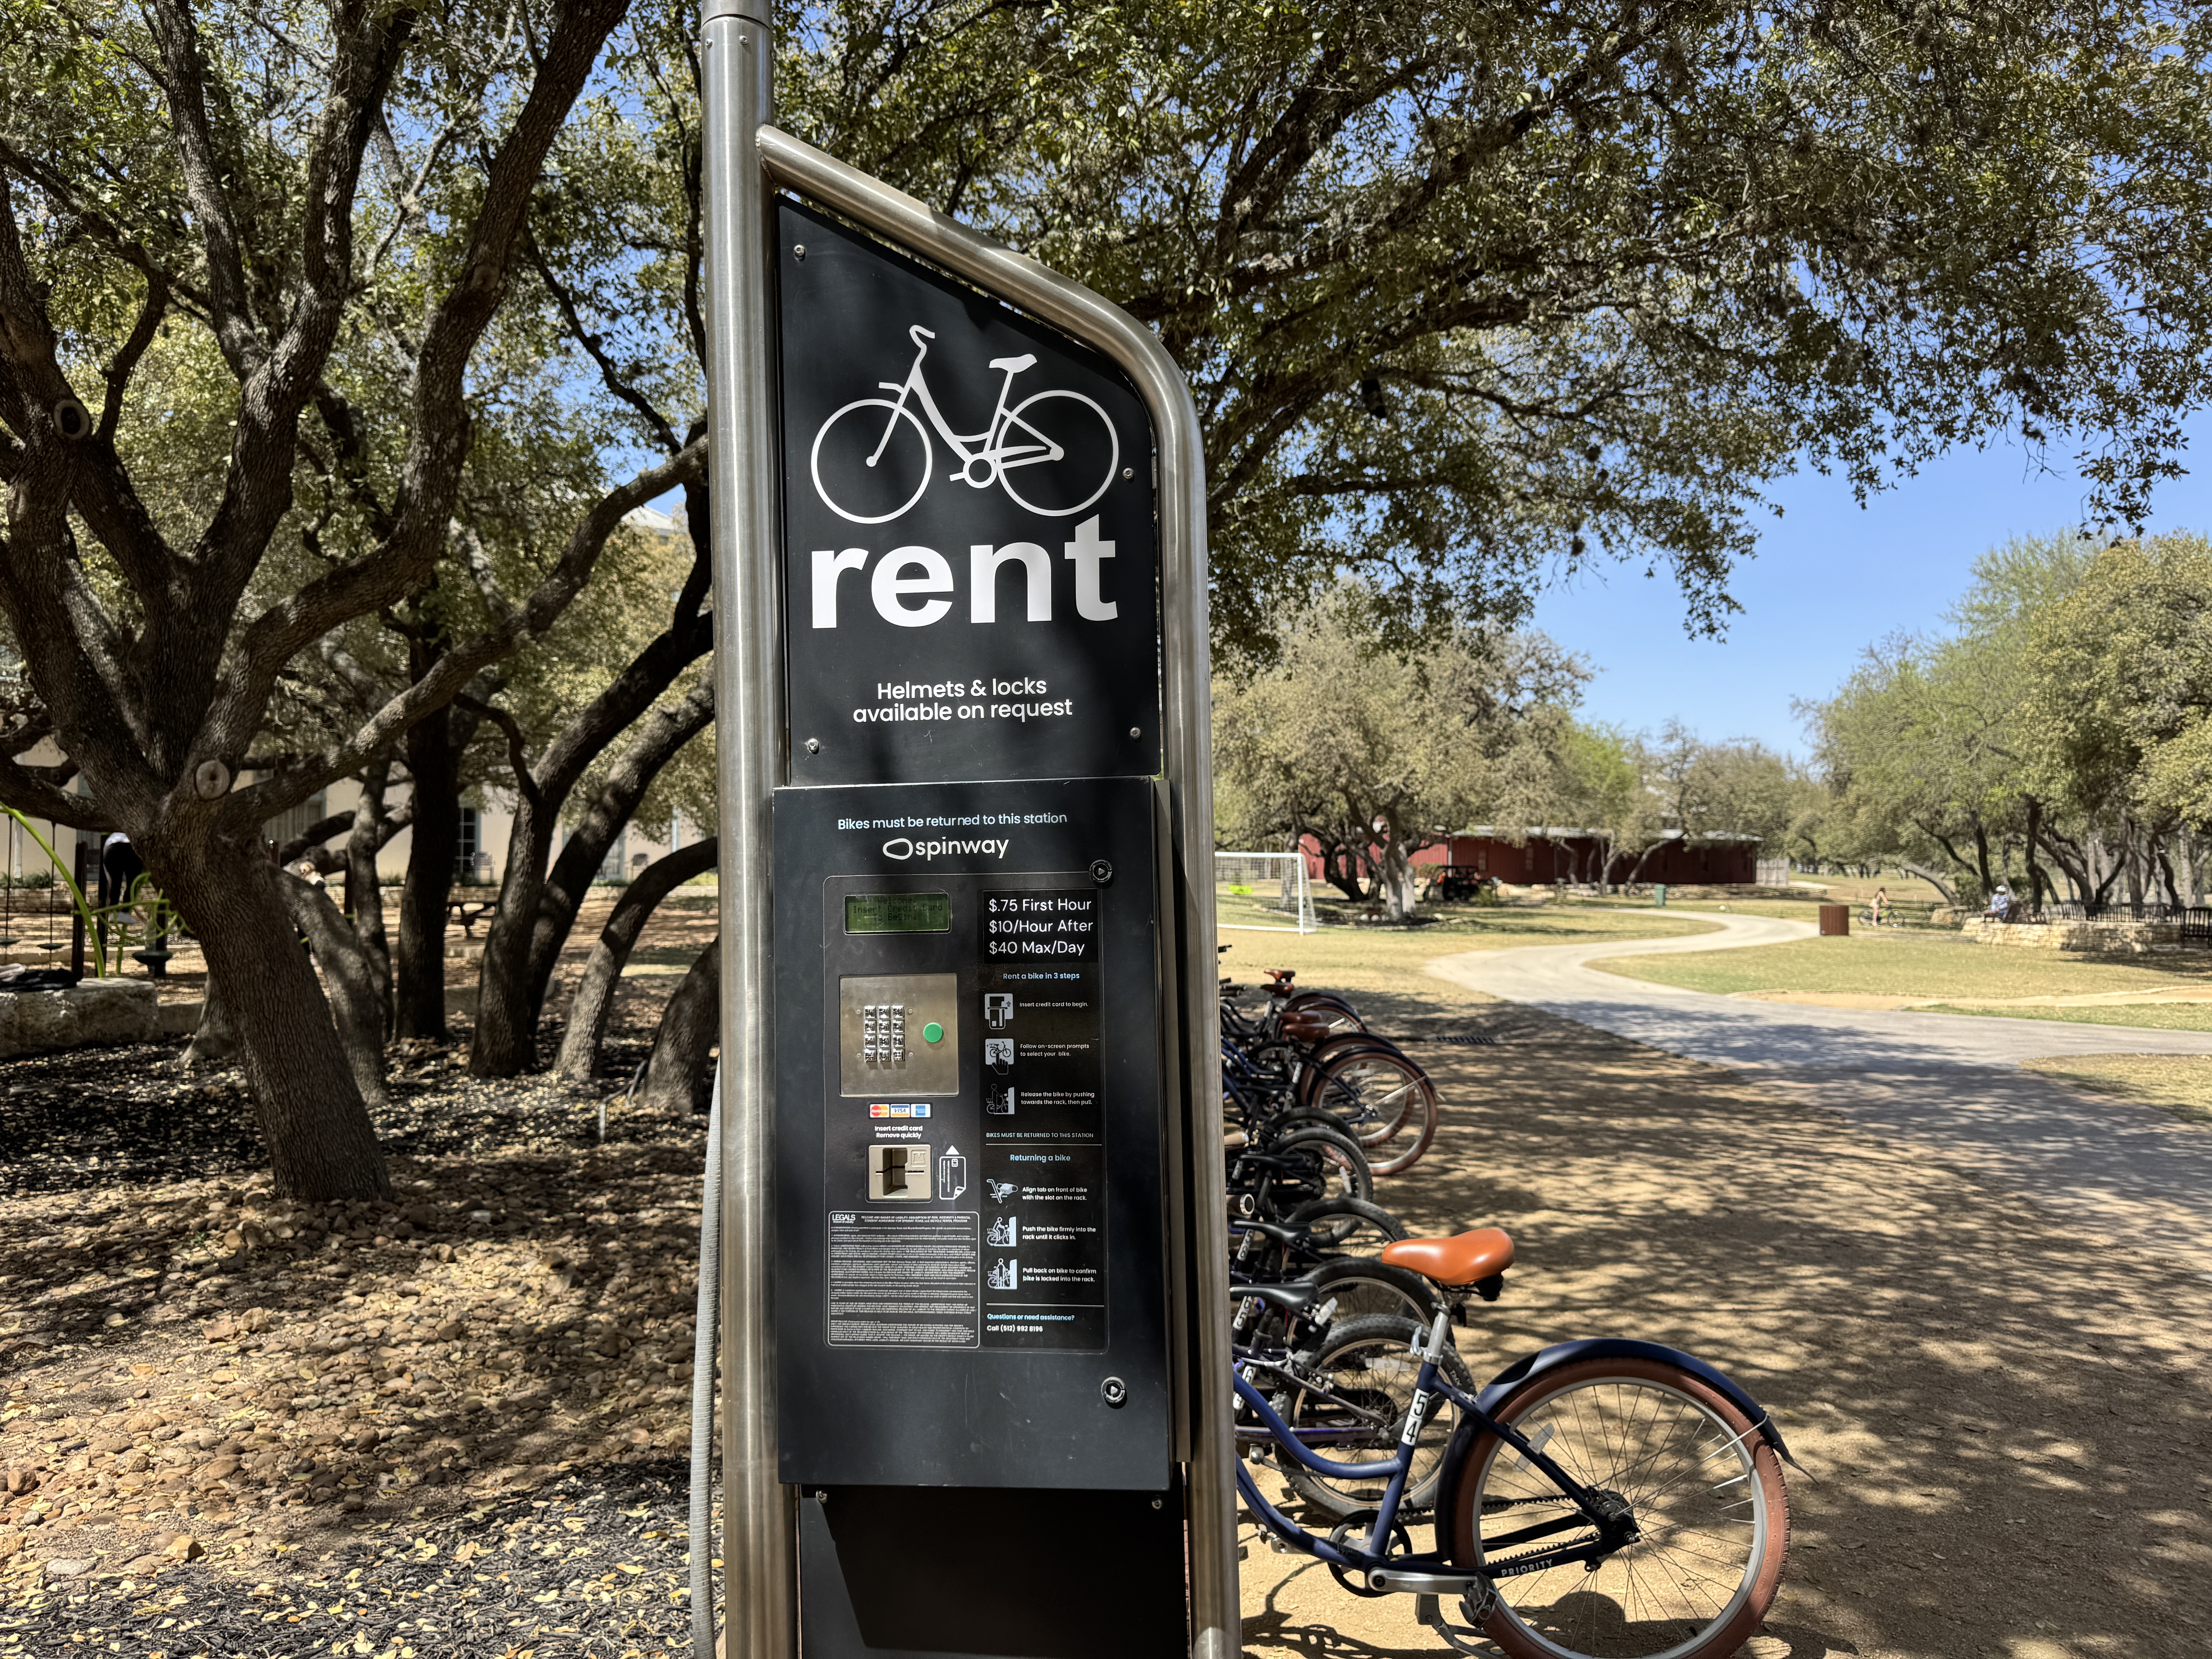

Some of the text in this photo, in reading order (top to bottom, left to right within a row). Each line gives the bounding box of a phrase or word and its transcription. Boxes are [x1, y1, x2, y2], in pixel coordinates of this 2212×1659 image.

[812, 514, 1118, 629] rent
[878, 677, 1046, 699] Helmets & locks
[854, 699, 1072, 722] available on request
[838, 812, 1067, 830] Bikes must be returned to this station
[916, 837, 1009, 860] spinway
[989, 898, 1091, 912] $.75 First Hour
[989, 919, 1093, 934] $10/Hour After
[989, 940, 1084, 956] $40 Max/Day
[1010, 1154, 1046, 1163] Returning
[1407, 1394, 1427, 1442] 54
[1501, 1559, 1552, 1577] PRIORITY
